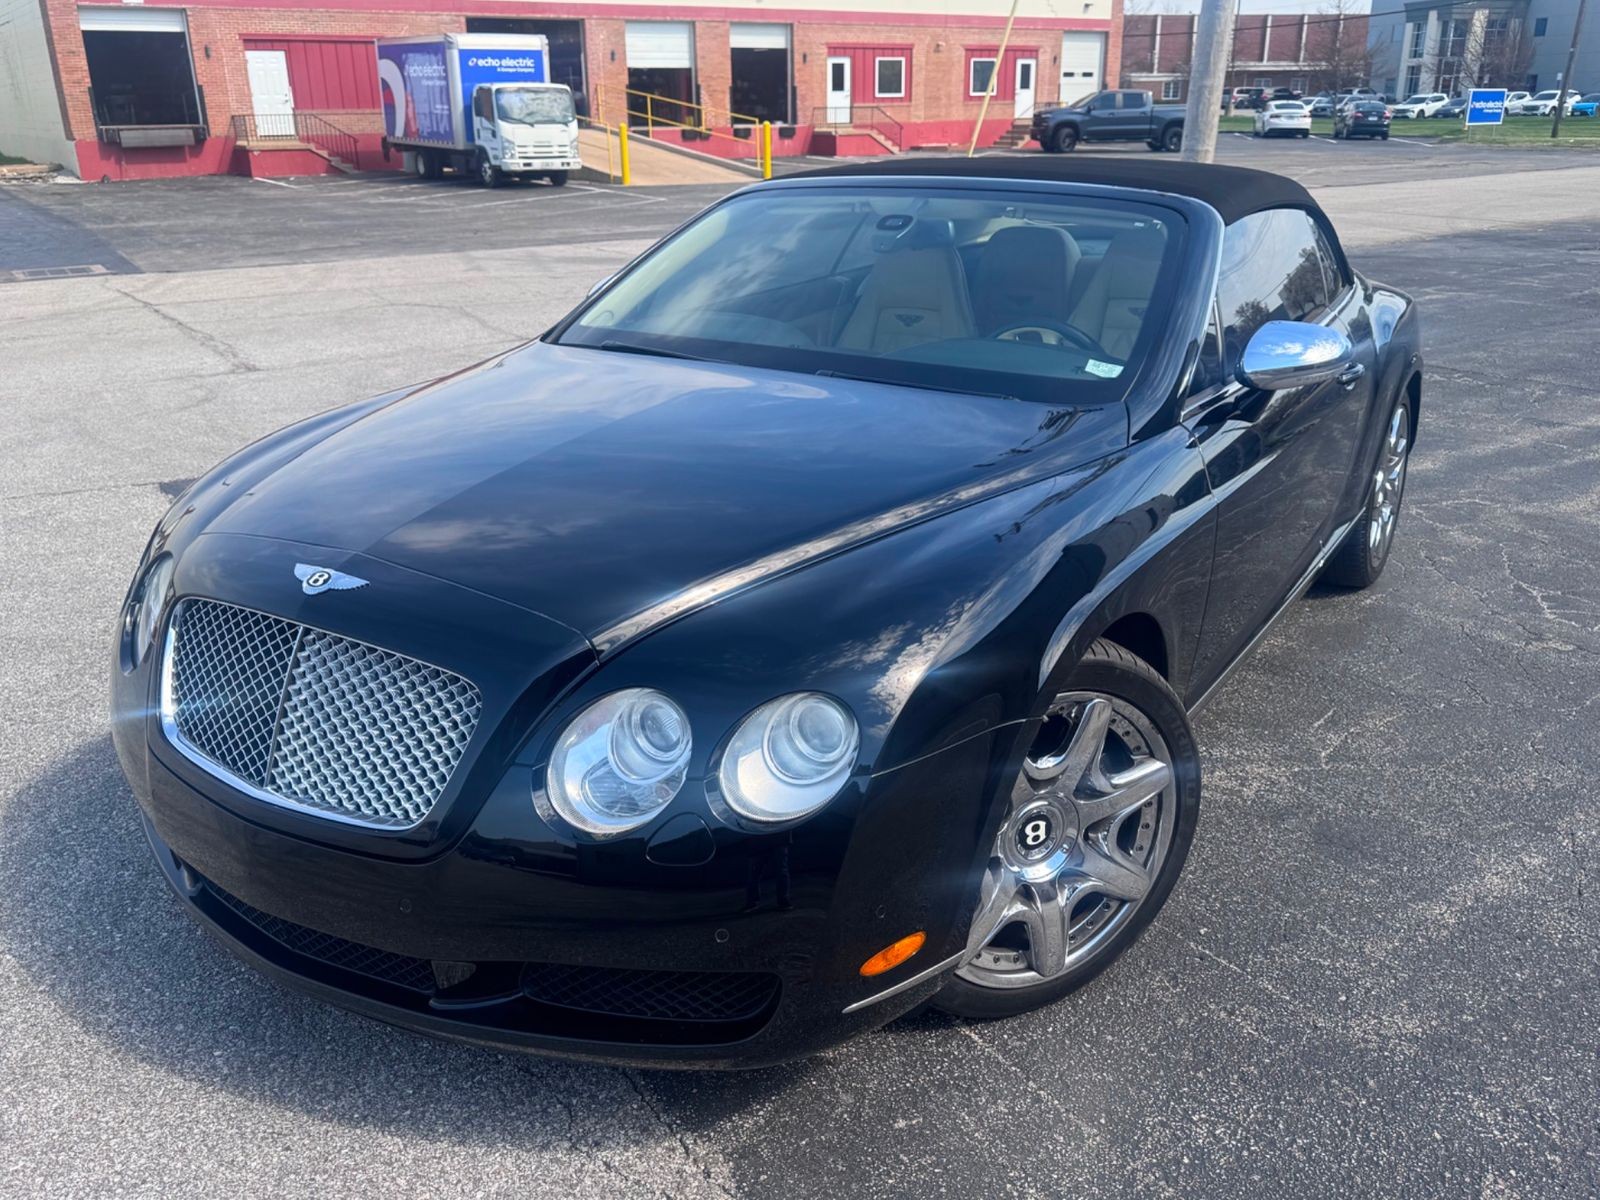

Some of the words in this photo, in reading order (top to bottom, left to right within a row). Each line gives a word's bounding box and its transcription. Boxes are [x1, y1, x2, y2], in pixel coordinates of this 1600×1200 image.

[477, 57, 500, 67] echo
[501, 57, 535, 67] electric
[308, 572, 329, 586] B
[1025, 820, 1046, 845] B
